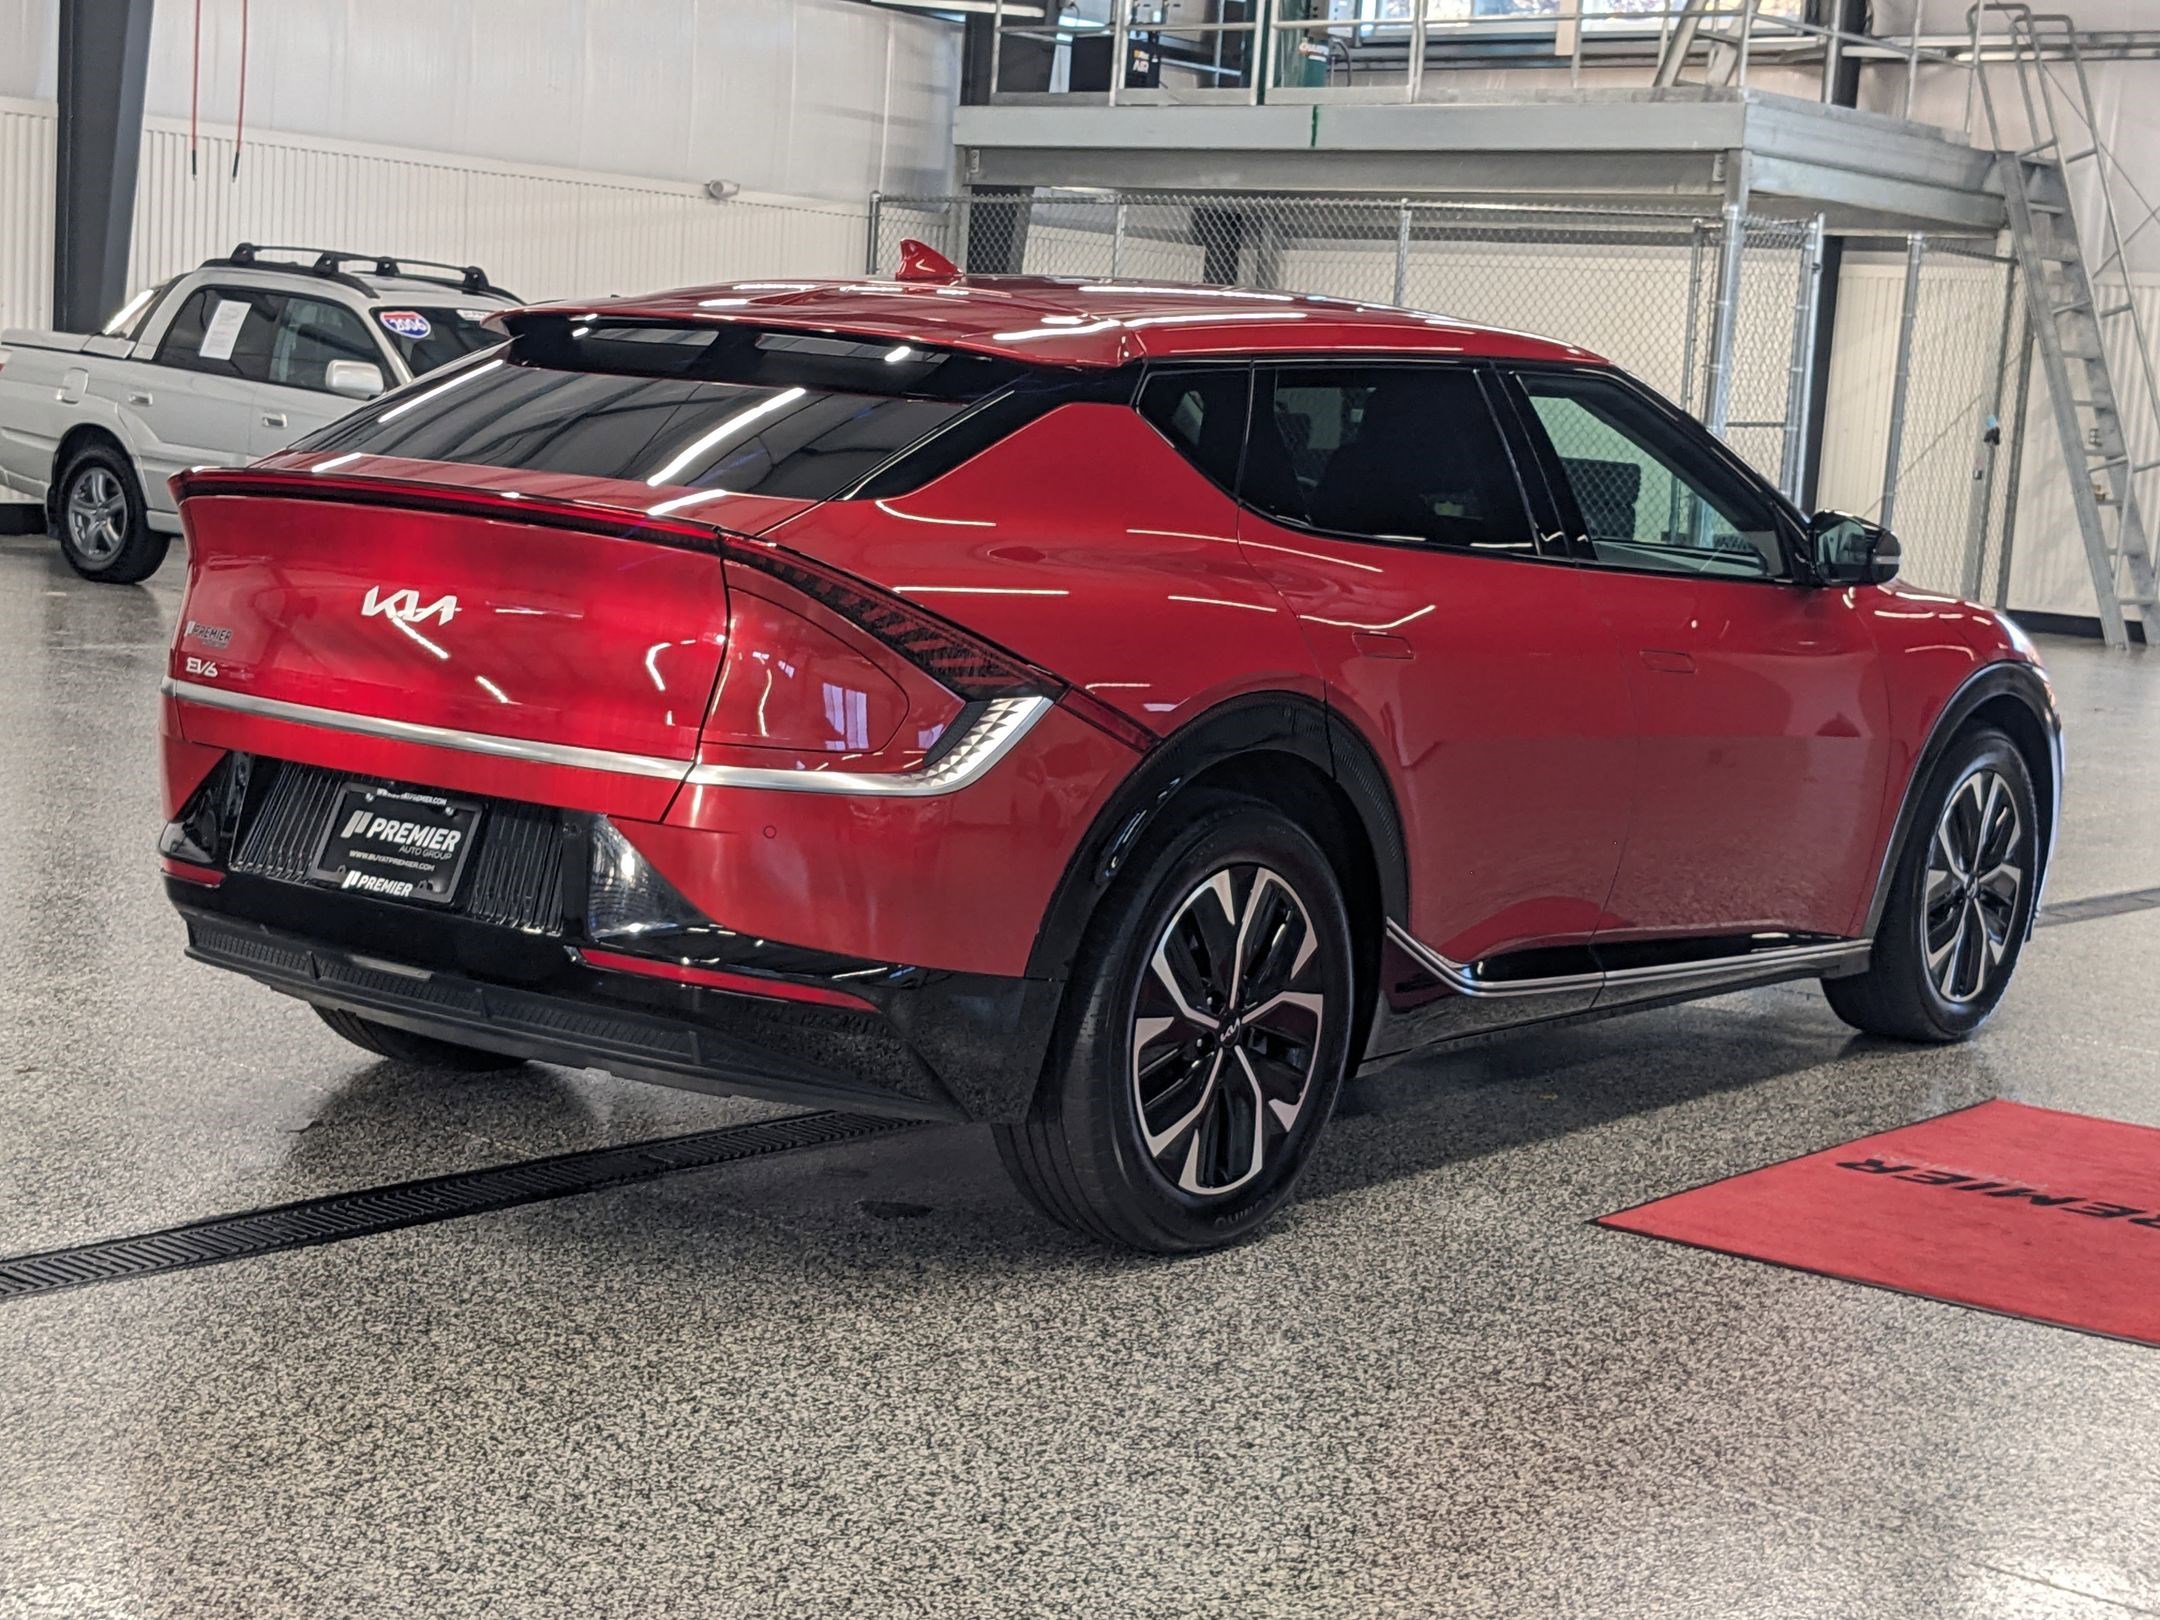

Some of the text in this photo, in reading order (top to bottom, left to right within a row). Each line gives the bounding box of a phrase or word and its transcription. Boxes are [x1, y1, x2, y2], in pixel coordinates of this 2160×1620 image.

[361, 585, 457, 626] KIA
[192, 624, 232, 642] PREMIER
[186, 656, 218, 678] EV6
[366, 817, 461, 852] PREMIER
[399, 845, 452, 861] AUTO GROUP
[358, 874, 413, 897] PREMIER
